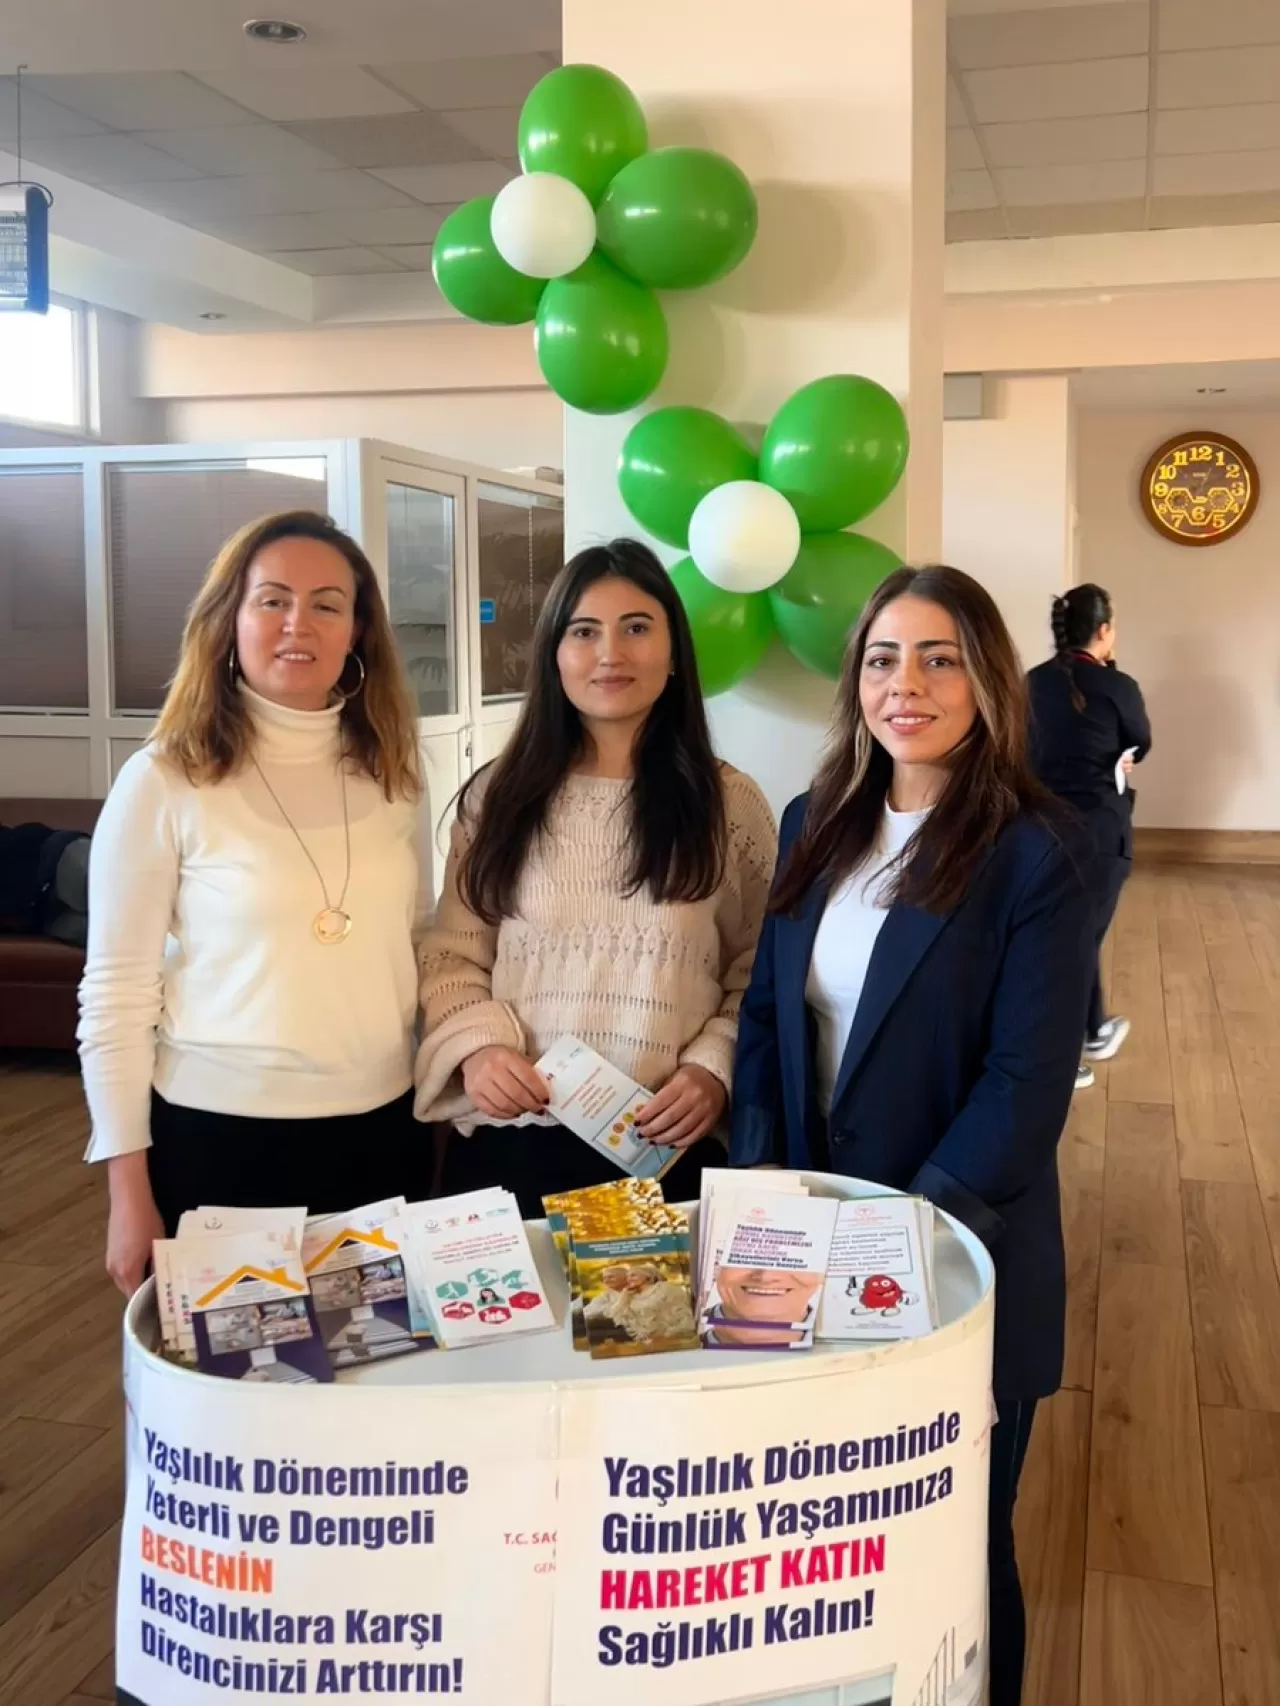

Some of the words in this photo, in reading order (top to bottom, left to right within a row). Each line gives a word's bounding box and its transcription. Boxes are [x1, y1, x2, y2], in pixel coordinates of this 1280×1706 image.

[1173, 451, 1188, 466] 11
[1189, 446, 1213, 461] 12
[1215, 452, 1225, 466] 1
[1159, 465, 1177, 480] 10
[1225, 464, 1240, 479] 2
[1154, 482, 1169, 497] 9
[1231, 482, 1245, 497] 3
[1191, 506, 1206, 521] 6
[1171, 514, 1184, 529] 7
[1212, 514, 1226, 529] 5
[144, 1427, 244, 1493] Yaşlılık
[253, 1458, 469, 1496] Döneminde
[604, 1452, 754, 1507] Yaşlılık
[764, 1411, 961, 1486] Döneminde
[144, 1473, 230, 1540] Yeterli
[238, 1512, 280, 1544] ve
[289, 1509, 435, 1550] Dengeli
[602, 1506, 746, 1554] Günlük
[757, 1465, 954, 1540] Yaşamınıza
[503, 1532, 528, 1545] T.C.
[141, 1524, 273, 1594] BESLENİN
[600, 1553, 772, 1609] HAREKET
[780, 1534, 886, 1589] KATIN
[140, 1573, 334, 1644] Hastalıklara
[345, 1609, 443, 1650] Karşı
[598, 1613, 754, 1669] Sağlıklı
[764, 1589, 875, 1645] Kalın!
[141, 1620, 307, 1693] Direncinizi
[315, 1657, 464, 1693] Arttırın!
